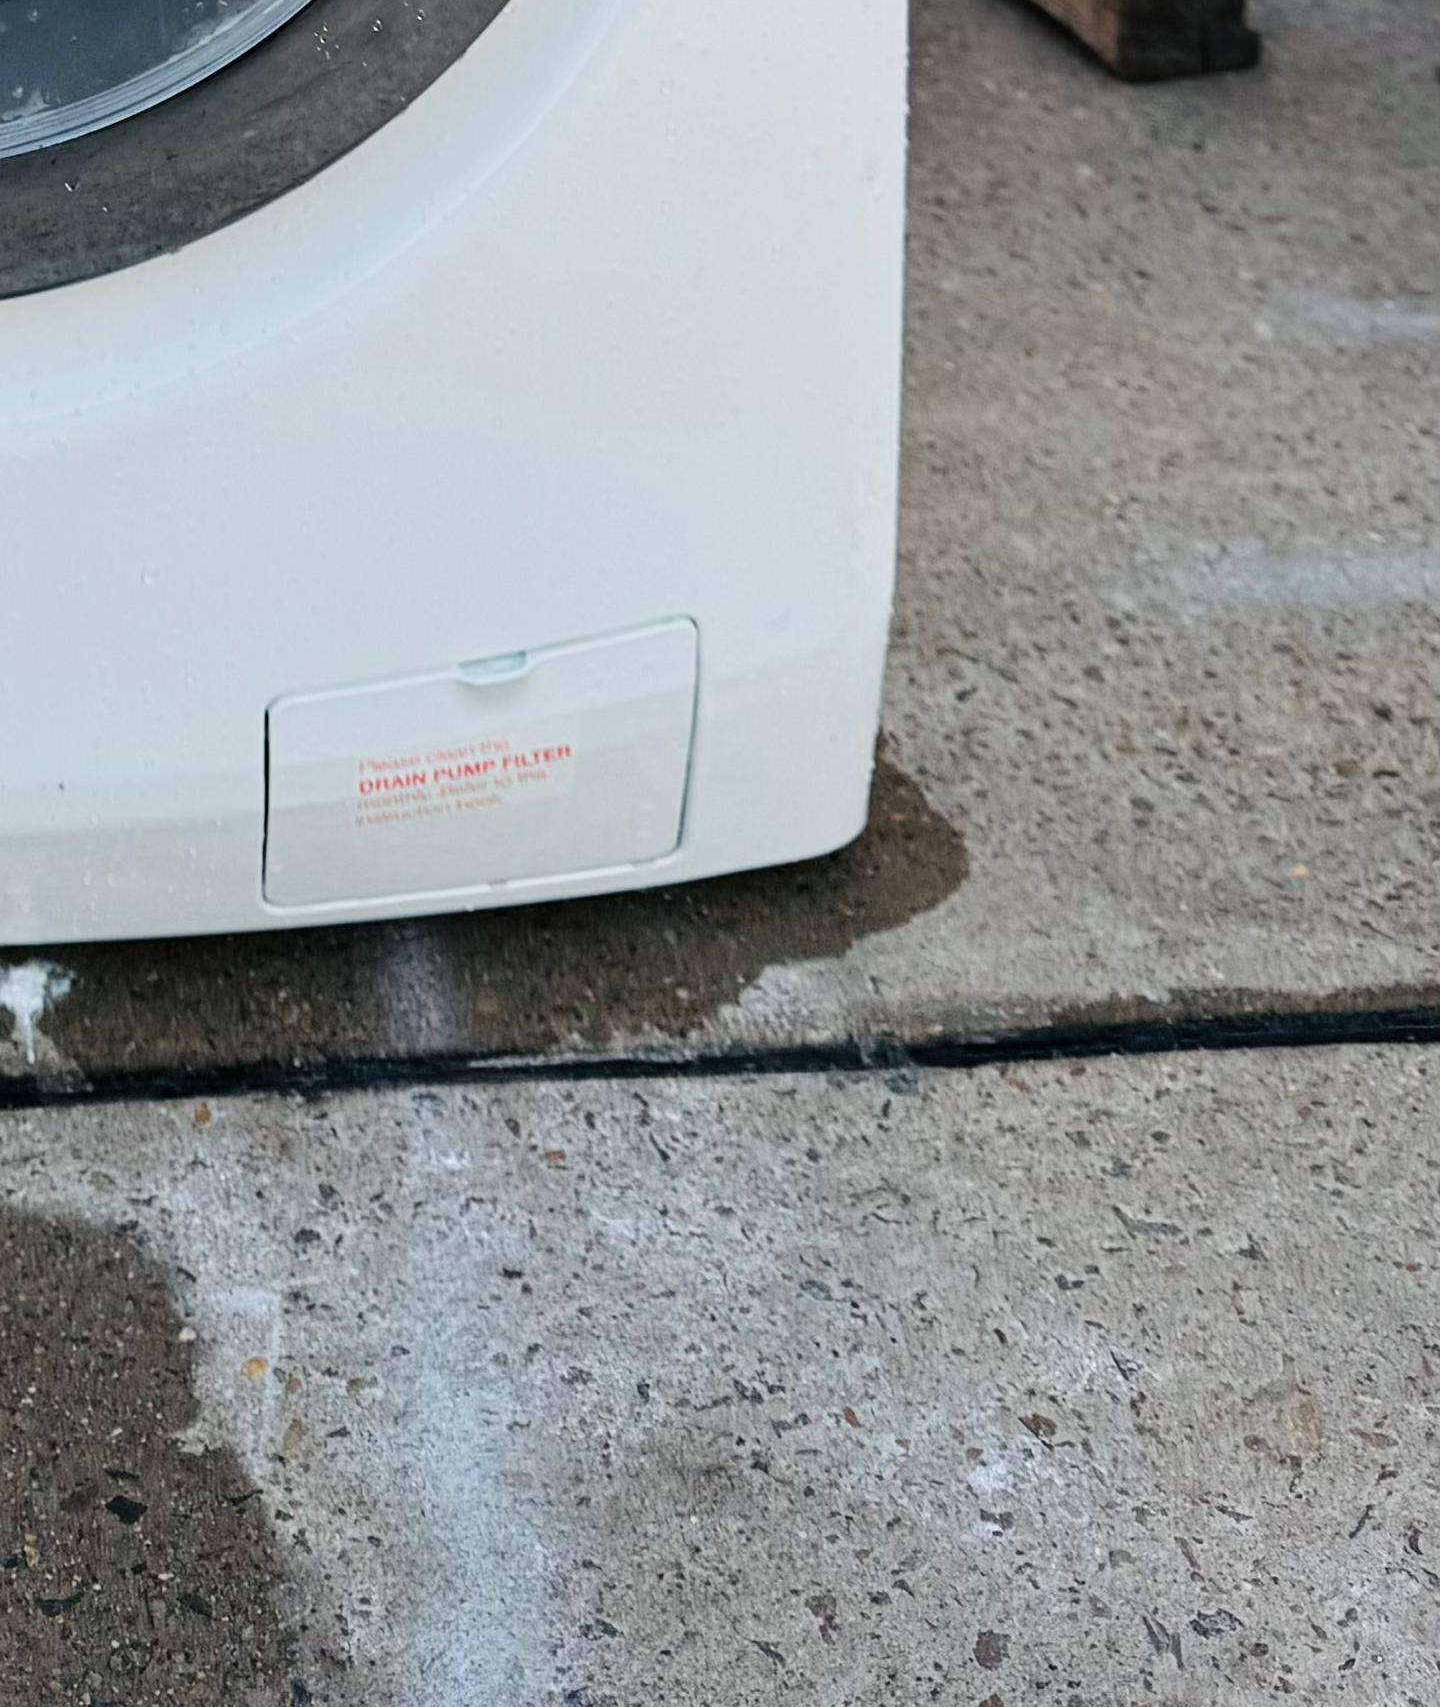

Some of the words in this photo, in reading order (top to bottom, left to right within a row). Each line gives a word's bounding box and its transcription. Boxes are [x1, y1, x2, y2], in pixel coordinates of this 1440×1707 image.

[359, 771, 426, 795] DRAIN
[432, 759, 496, 782] PUMP
[502, 744, 573, 770] FILTER
